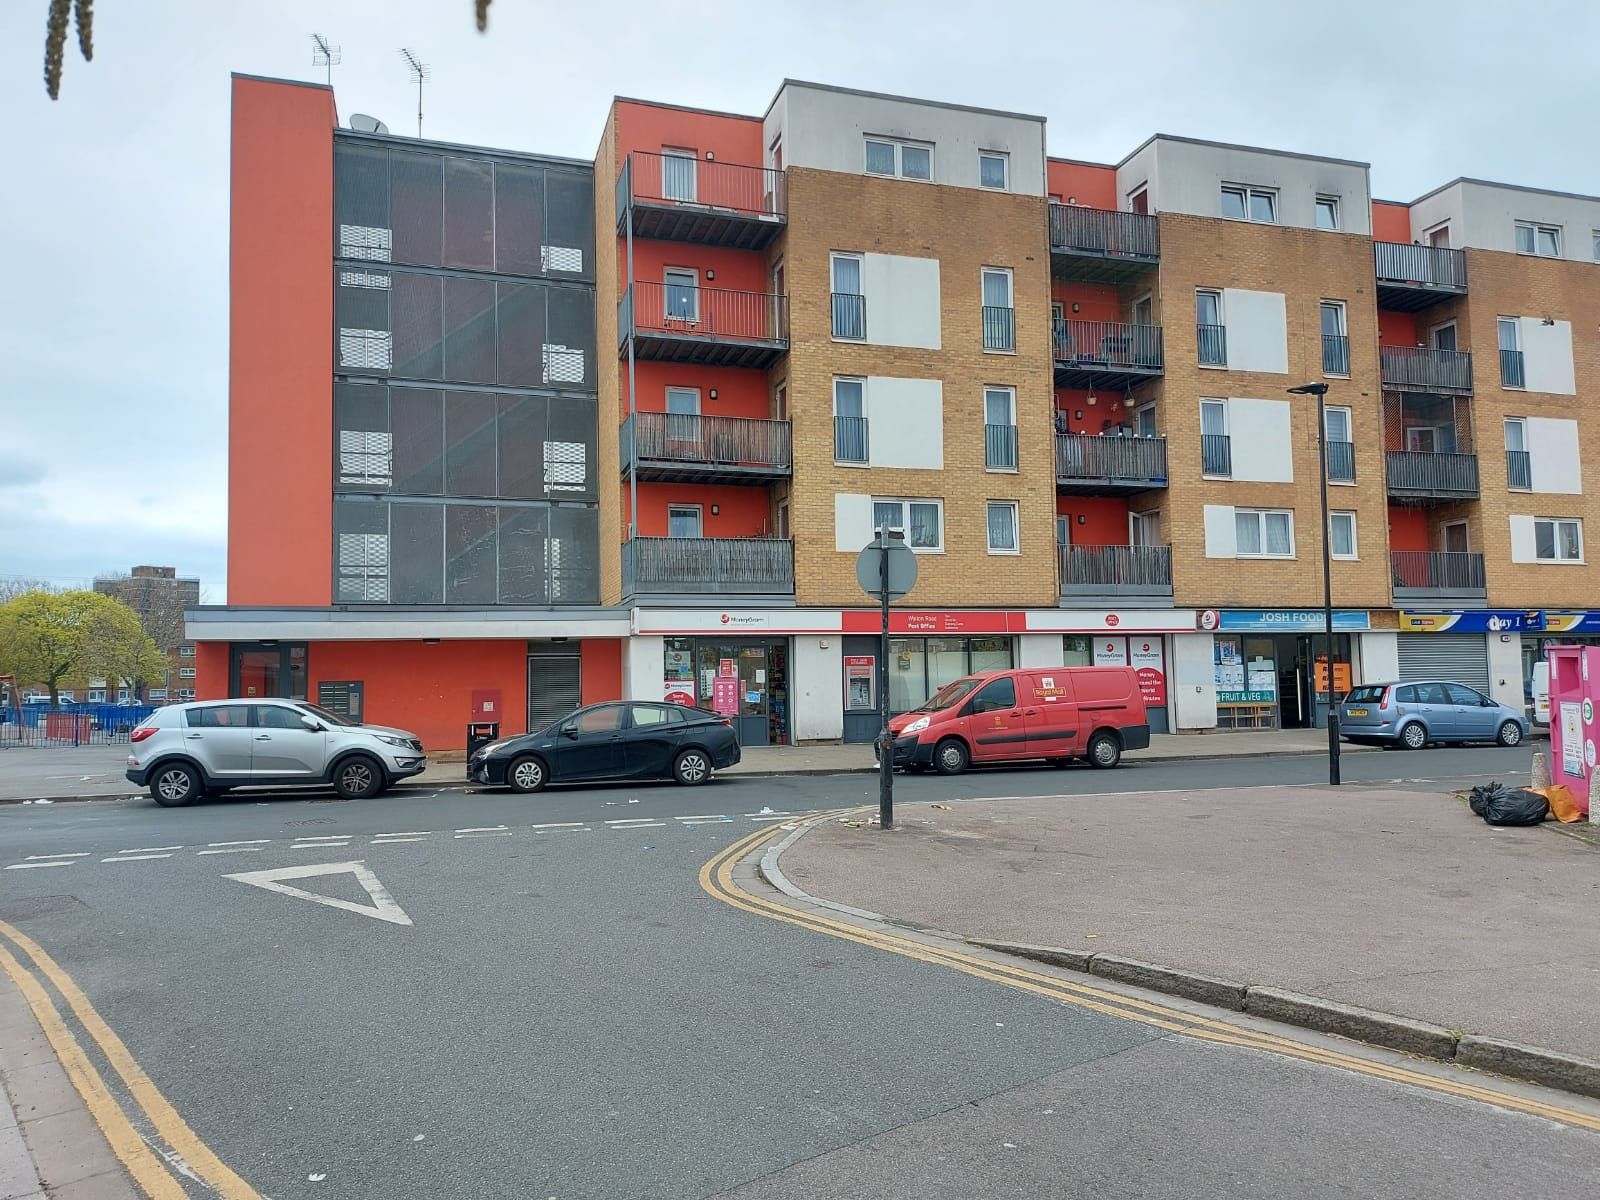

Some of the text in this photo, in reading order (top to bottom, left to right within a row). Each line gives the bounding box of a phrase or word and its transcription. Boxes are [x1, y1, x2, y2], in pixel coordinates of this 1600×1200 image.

[1260, 612, 1326, 622] JOSH FOOD
[1035, 688, 1065, 697] Royal Mail
[1221, 692, 1241, 702] FRUIT
[1247, 692, 1261, 701] VEG
